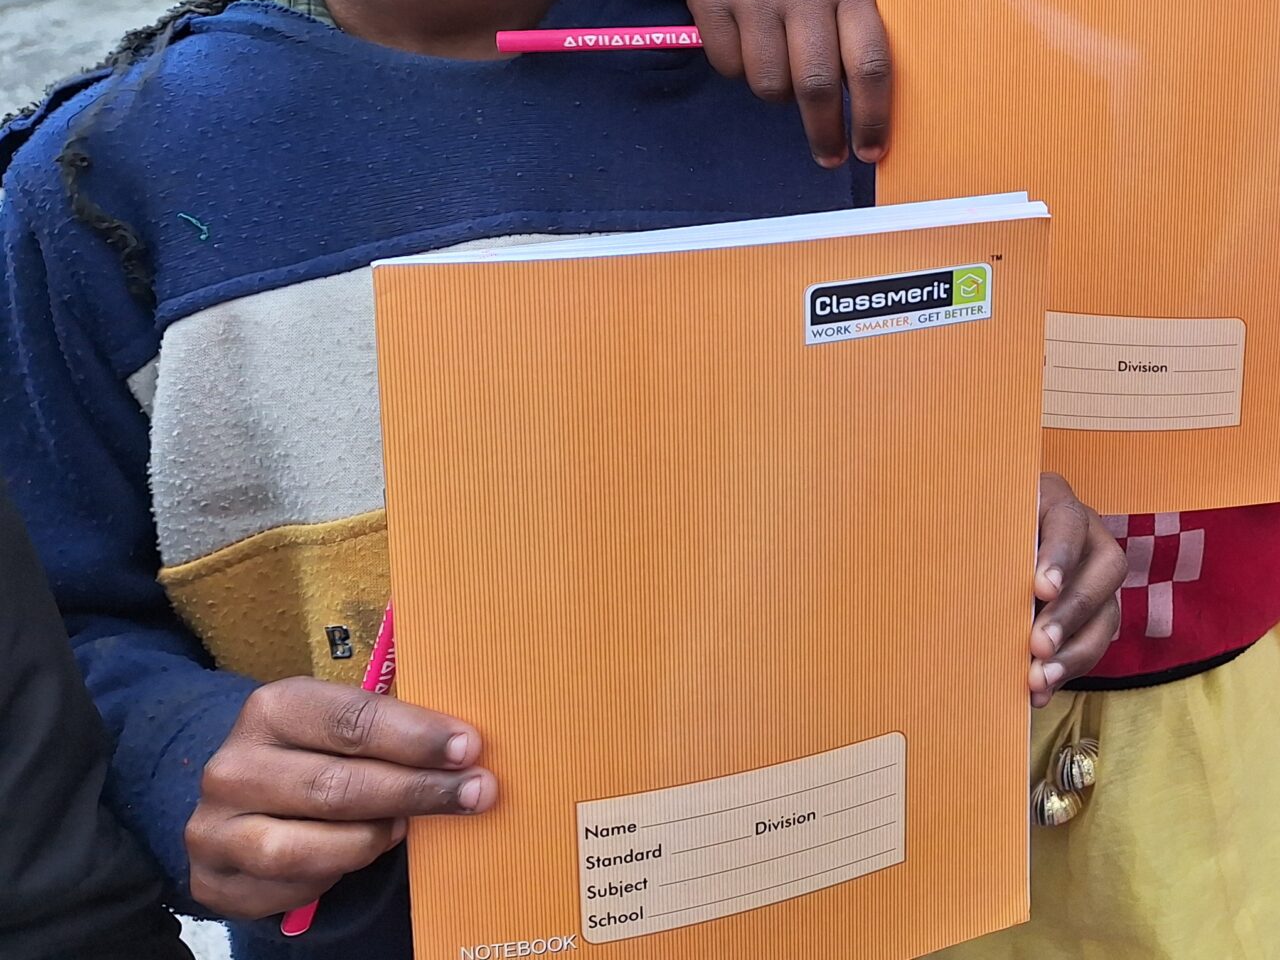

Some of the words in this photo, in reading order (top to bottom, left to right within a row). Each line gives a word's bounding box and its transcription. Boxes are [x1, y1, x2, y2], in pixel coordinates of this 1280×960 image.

[815, 281, 950, 316] Classmerit
[812, 326, 851, 338] WORK
[855, 316, 913, 333] SMARTER,
[918, 312, 941, 324] GET
[944, 304, 987, 319] BETTER.
[1118, 360, 1168, 373] Division
[585, 822, 637, 840] Name
[586, 844, 662, 870] Standard
[755, 810, 816, 836] Division
[586, 878, 648, 900] Subject
[588, 906, 644, 929] School
[460, 934, 577, 960] NOTEBOOK
